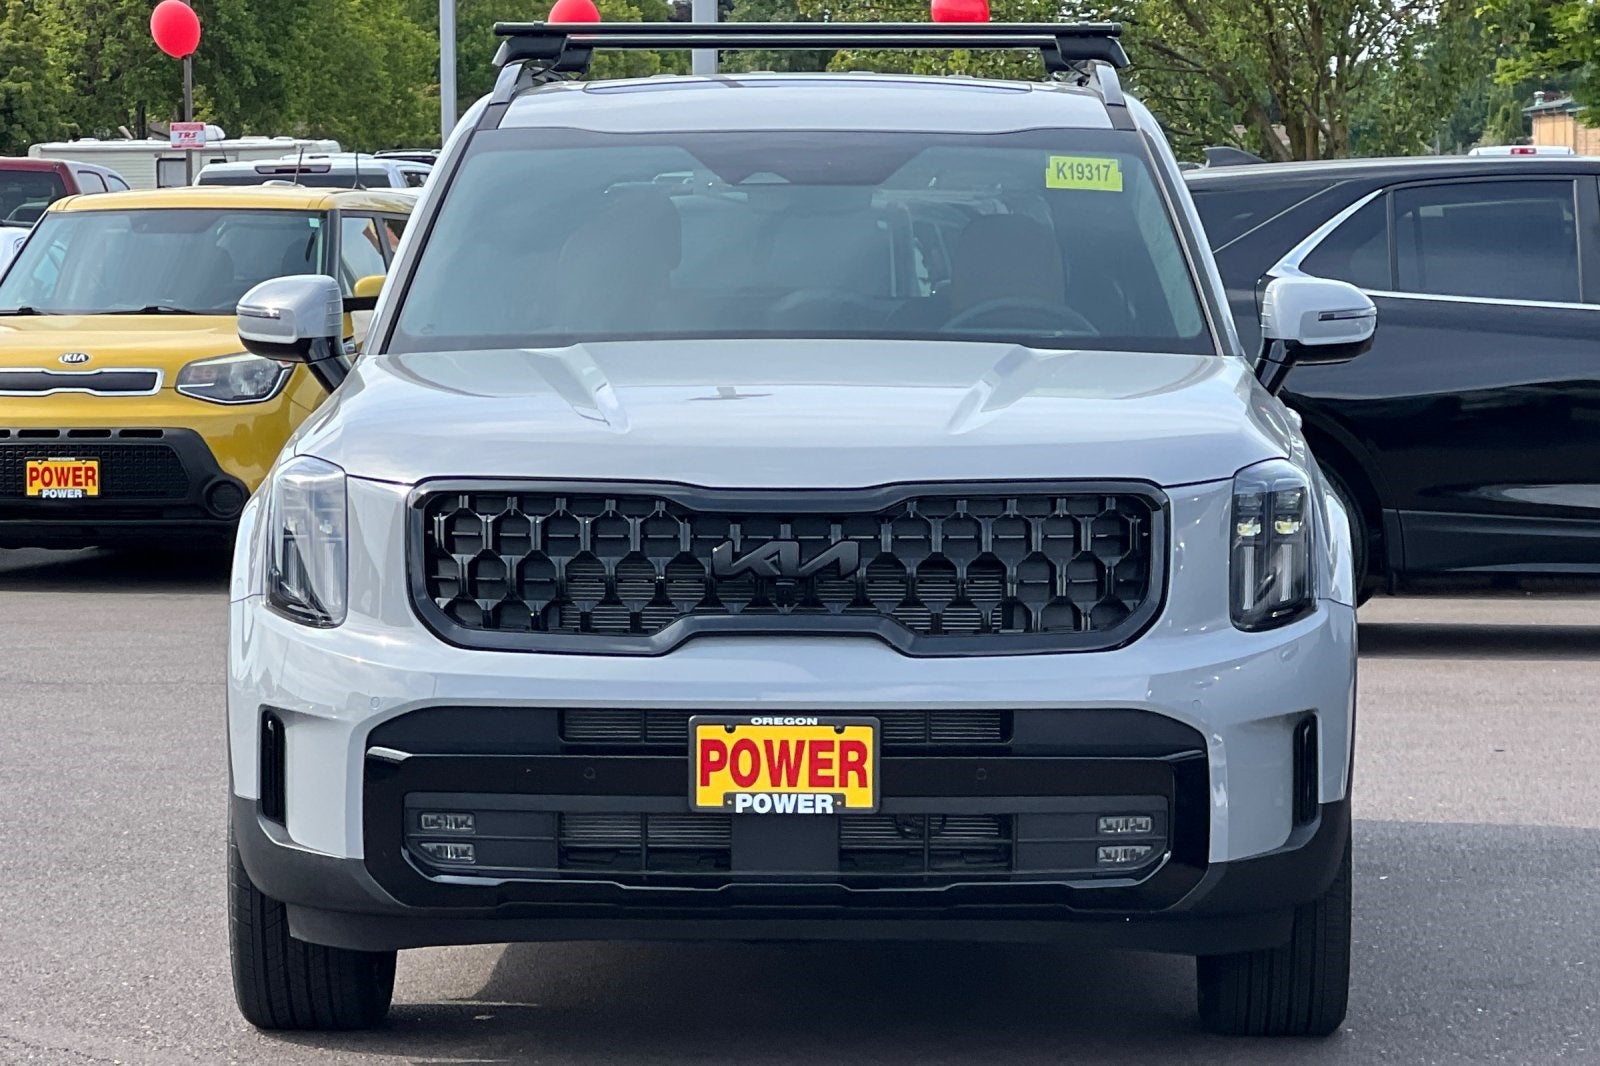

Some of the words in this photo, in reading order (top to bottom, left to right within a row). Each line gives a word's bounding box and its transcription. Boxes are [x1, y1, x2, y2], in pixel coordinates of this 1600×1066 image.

[1056, 161, 1111, 182] K19317
[63, 353, 86, 362] KIA
[29, 466, 97, 488] POWER
[42, 489, 83, 498] POWER
[750, 717, 818, 726] OREGON
[700, 738, 868, 788] POWER
[735, 793, 834, 814] POWER
